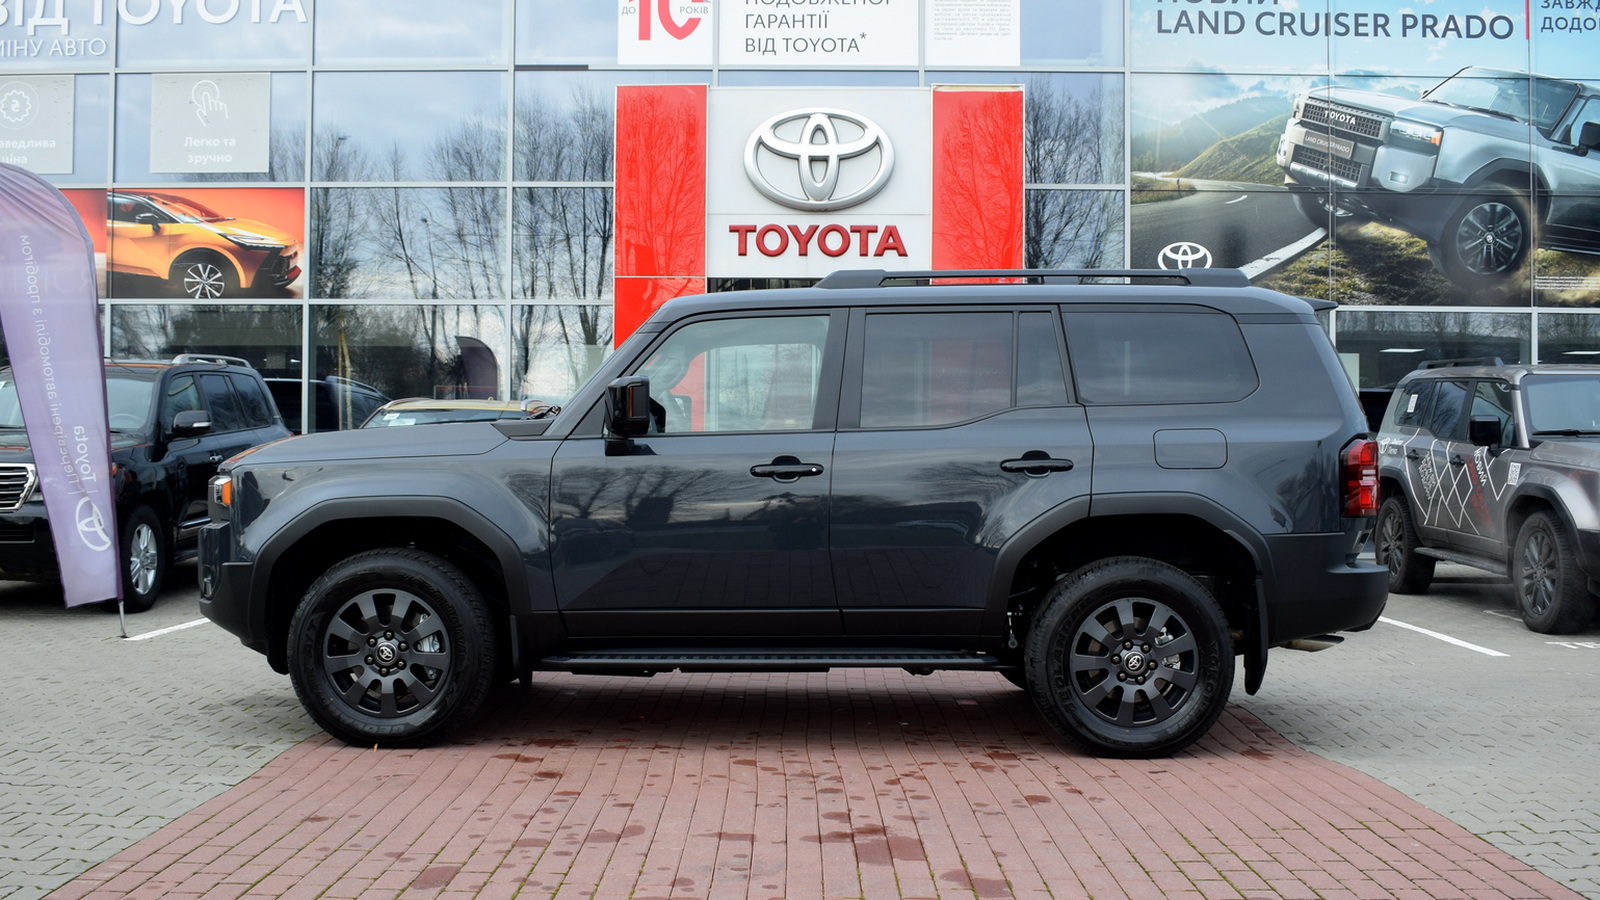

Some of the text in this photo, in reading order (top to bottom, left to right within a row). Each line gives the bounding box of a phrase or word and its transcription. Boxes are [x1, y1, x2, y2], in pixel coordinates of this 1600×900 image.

[621, 6, 637, 15] ДО
[679, 6, 709, 14] РОКІВ
[745, 10, 830, 29] ГАРАНТІЇ
[1156, 9, 1515, 39] LAND CRUISER PRADO
[1540, 16, 1600, 33] ДОДО
[49, 38, 107, 56] АВТО
[745, 38, 777, 55] ВІД
[1324, 110, 1356, 125] TOYOTA
[184, 136, 237, 149] Легко та
[187, 153, 233, 165] зручно
[728, 224, 909, 258] TOYOTA
